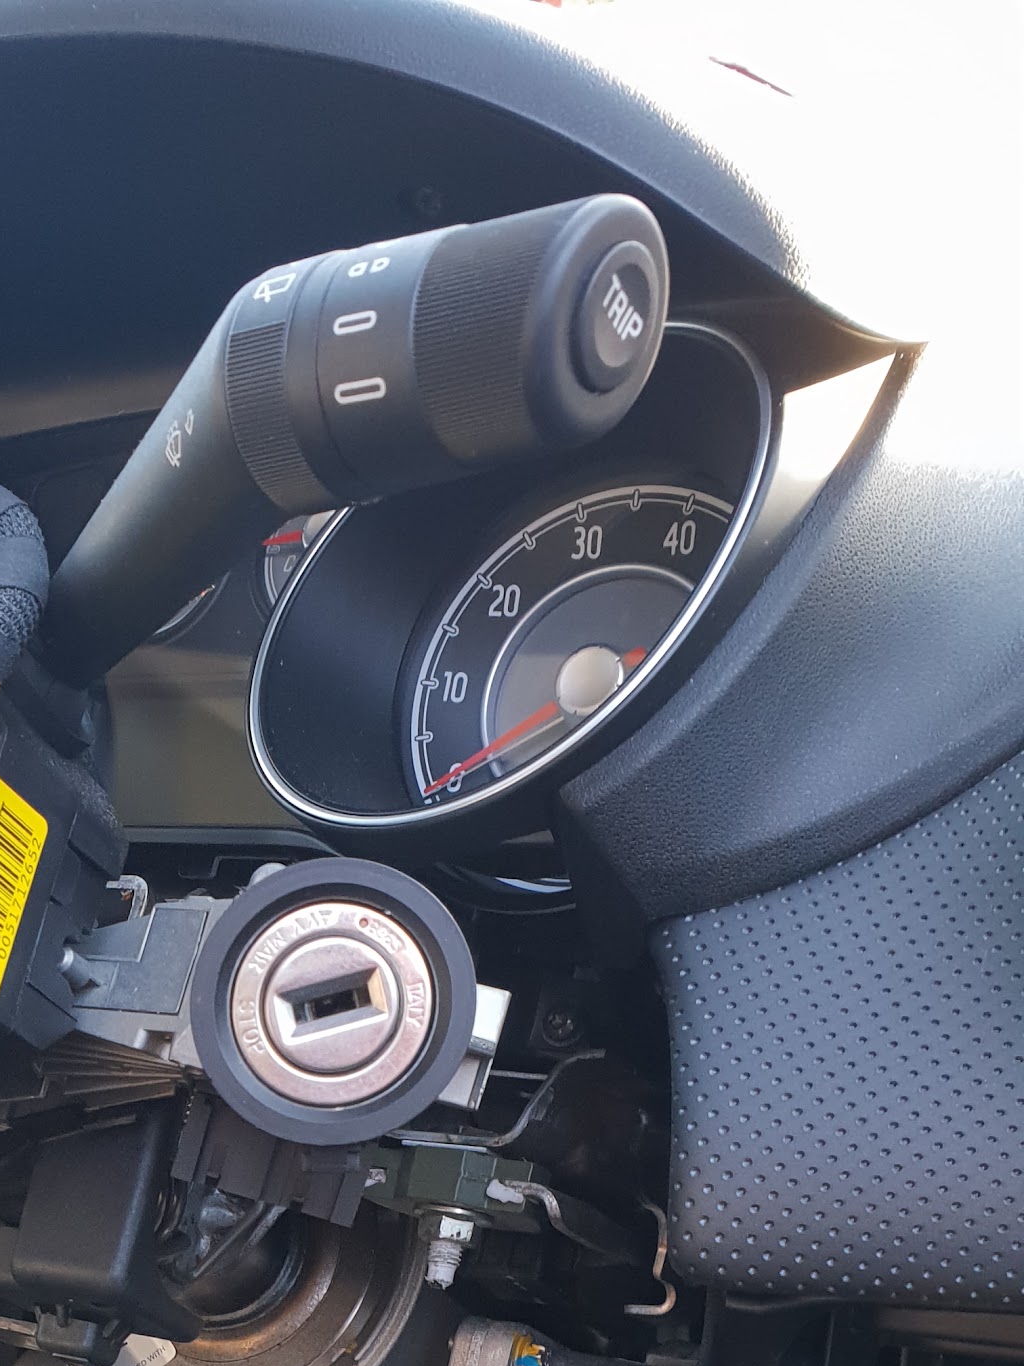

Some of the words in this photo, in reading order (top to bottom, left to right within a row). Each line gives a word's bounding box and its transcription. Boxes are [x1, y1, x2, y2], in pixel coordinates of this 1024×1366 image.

[602, 274, 645, 341] TRIP
[570, 525, 603, 560] 30
[662, 519, 697, 556] 40
[488, 583, 521, 618] 20
[442, 671, 468, 704] 10
[147, 1345, 166, 1363] WITH
